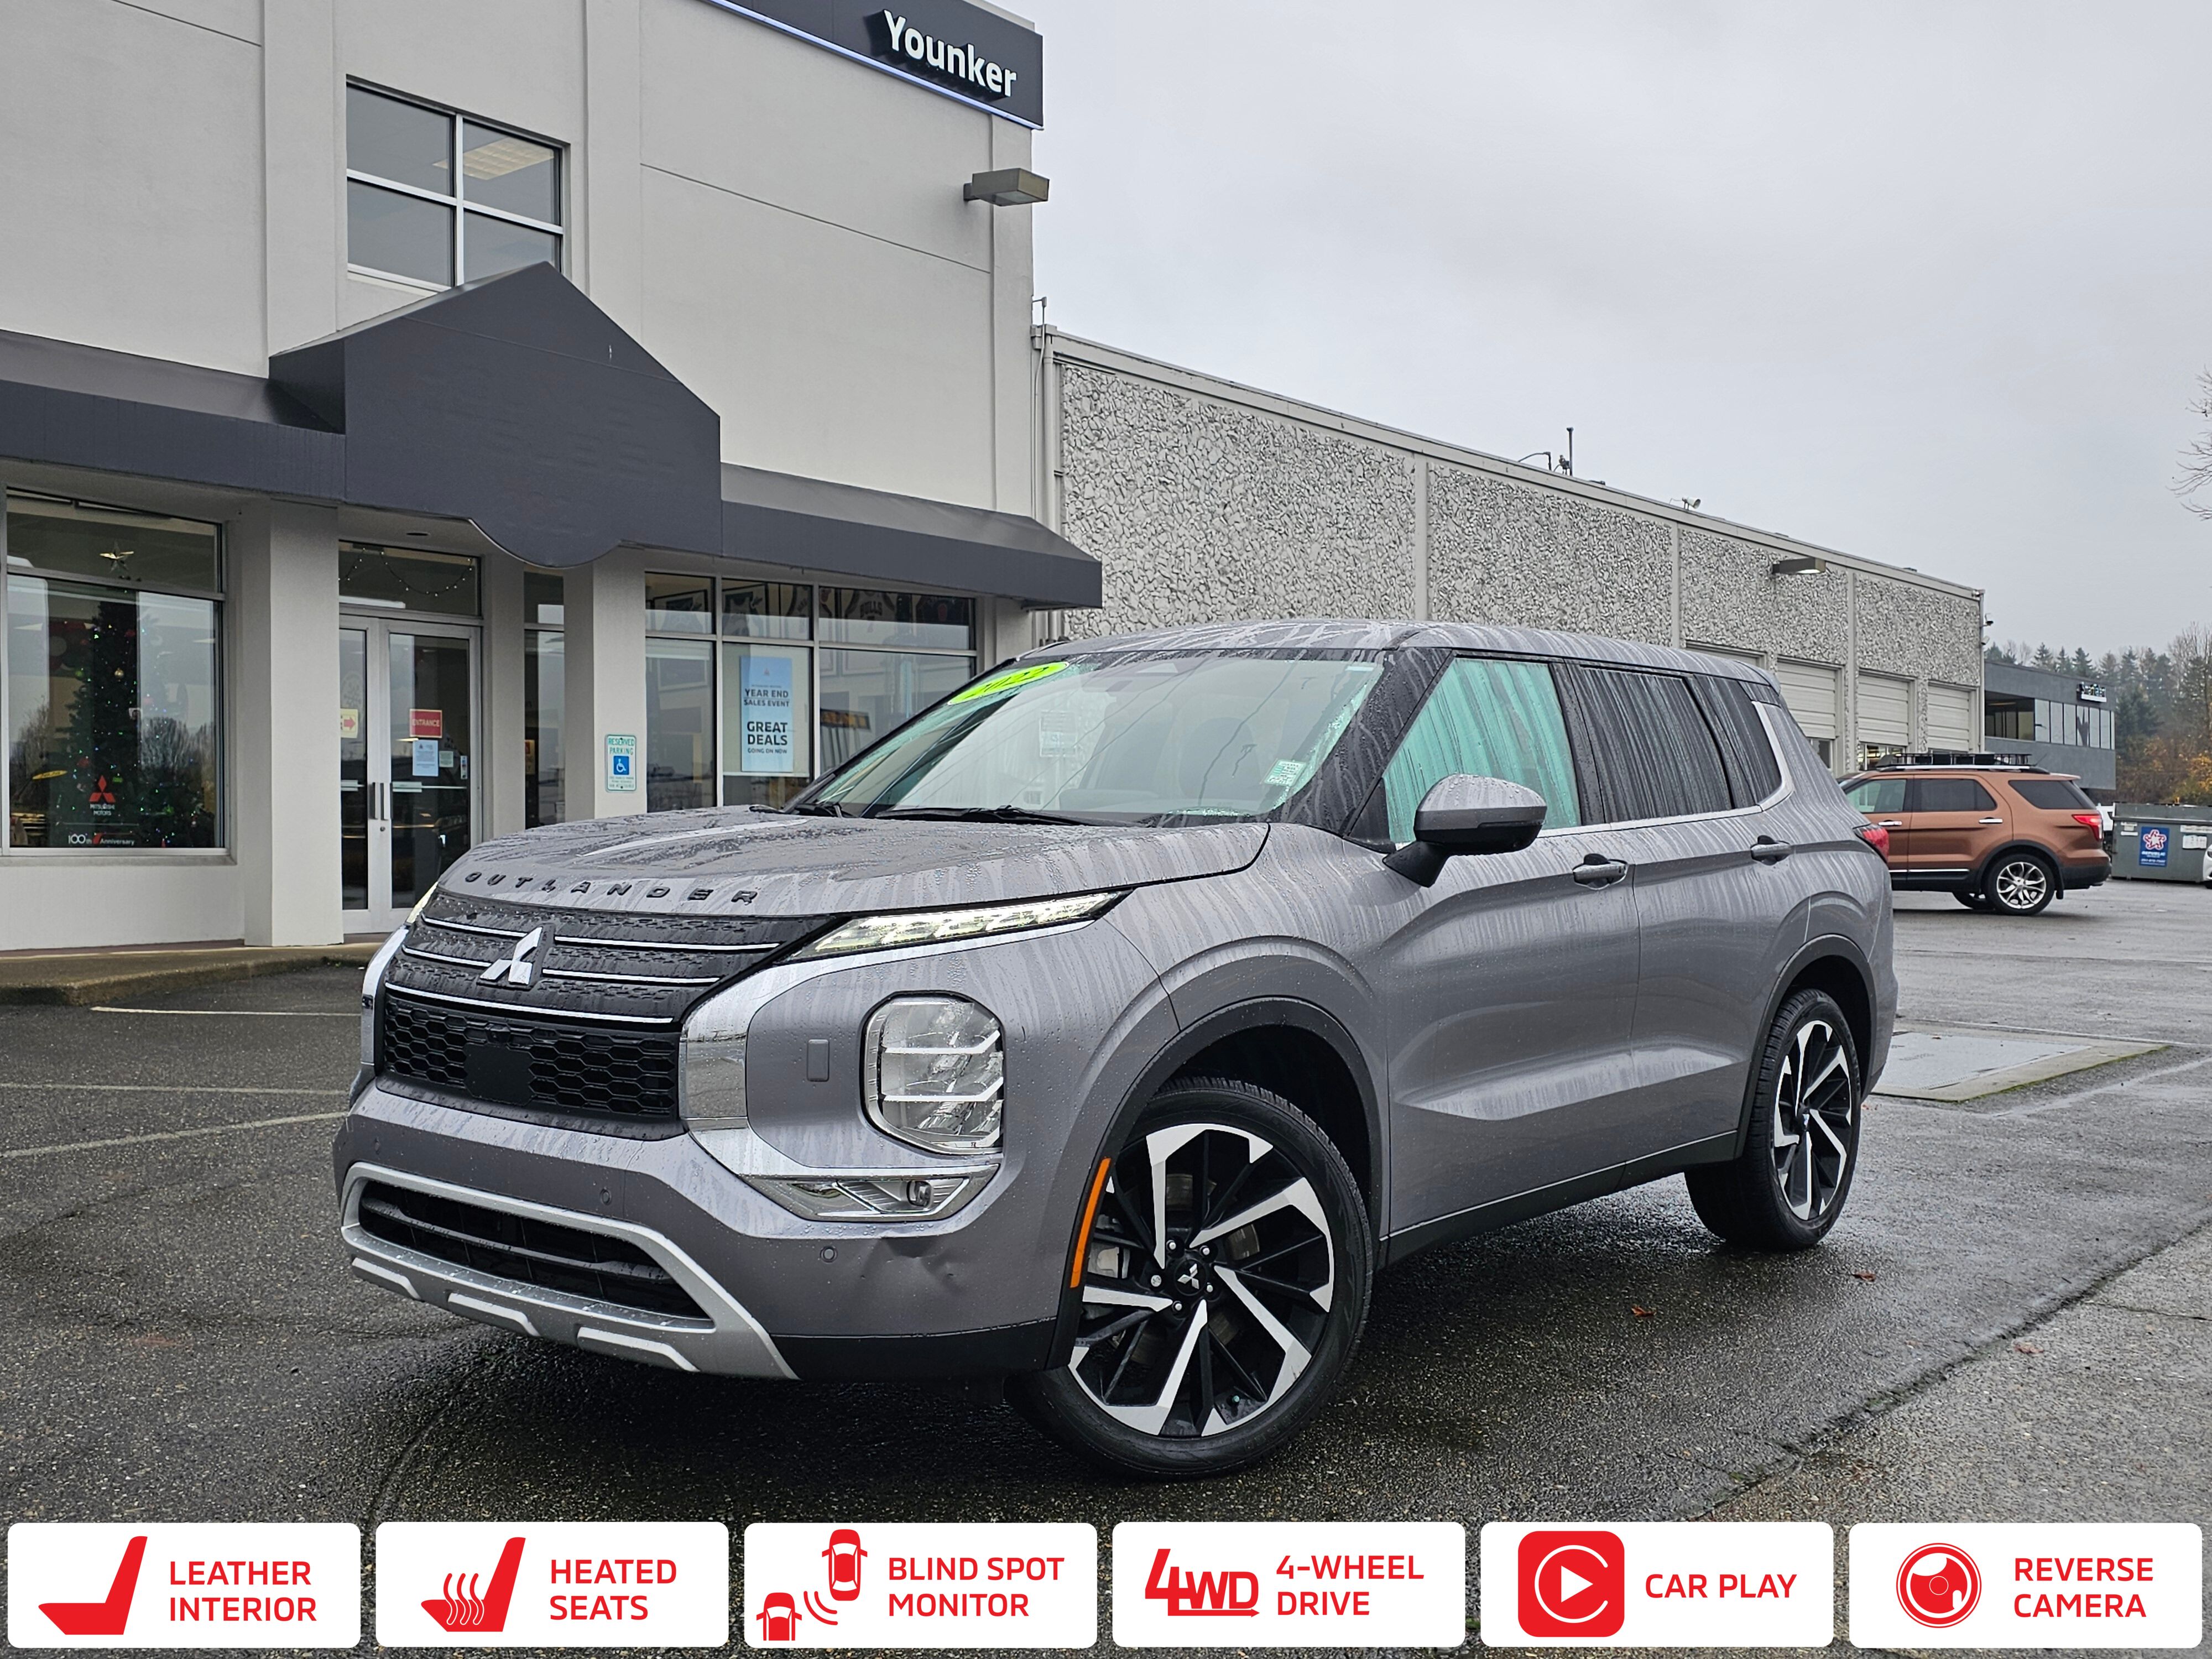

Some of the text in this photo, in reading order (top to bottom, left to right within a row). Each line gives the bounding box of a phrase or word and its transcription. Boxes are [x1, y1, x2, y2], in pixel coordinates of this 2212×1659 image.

[884, 9, 1017, 97] Younker
[745, 688, 789, 698] YEAR END
[413, 718, 440, 727] ENTRANCE
[747, 721, 788, 733] GREAT
[608, 738, 634, 746] RESERVED
[748, 734, 788, 745] DEALS
[609, 747, 633, 755] PARKING
[68, 834, 92, 844] 100th
[465, 871, 758, 906] OUTLANDER
